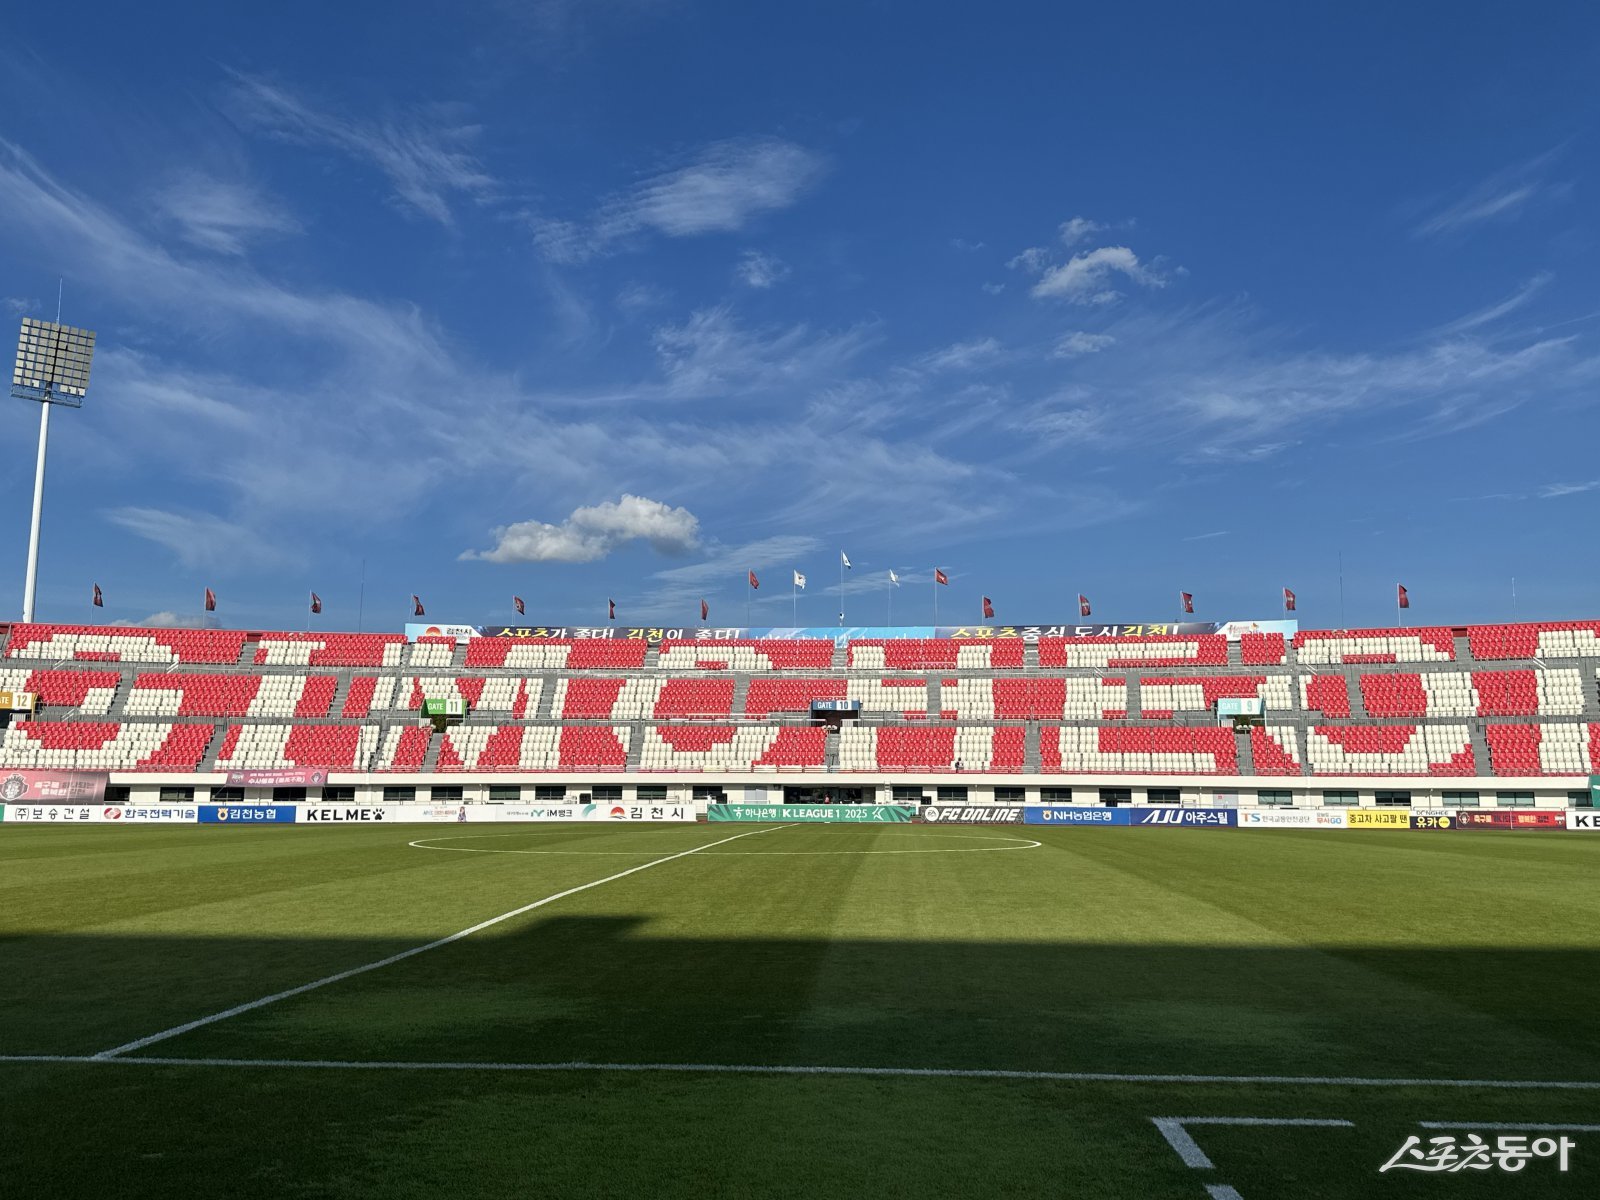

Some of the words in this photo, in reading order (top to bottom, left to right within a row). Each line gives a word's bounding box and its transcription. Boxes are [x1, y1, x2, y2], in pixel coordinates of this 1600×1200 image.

[496, 628, 567, 639] 스포츠가
[626, 628, 683, 643] 김천이
[17, 694, 28, 706] 12
[817, 701, 833, 709] GATE
[840, 701, 849, 710] 10
[1221, 702, 1238, 710] GATE
[1247, 700, 1253, 712] 9
[450, 701, 458, 712] 11
[124, 808, 196, 820] 한국전력기술
[230, 808, 277, 820] 김천농협
[307, 809, 371, 821] KELME
[547, 809, 572, 818] iM뱅크
[630, 807, 684, 820] 김천시
[745, 808, 776, 819] 하나은행
[783, 809, 792, 818] K
[793, 809, 836, 818] LEAGUE
[836, 809, 840, 818] 1
[844, 808, 868, 819] 2025
[938, 808, 961, 821] FC
[961, 808, 1021, 821] ONLINE
[1053, 811, 1112, 821] NH농협은행
[1141, 810, 1185, 824] AJU
[1185, 812, 1229, 825] 아주스틸
[1242, 813, 1261, 823] TS
[1350, 814, 1372, 824] 중고차
[1374, 814, 1397, 824] 사고팔
[1399, 814, 1408, 824] 땐
[1416, 816, 1437, 828] 유카
